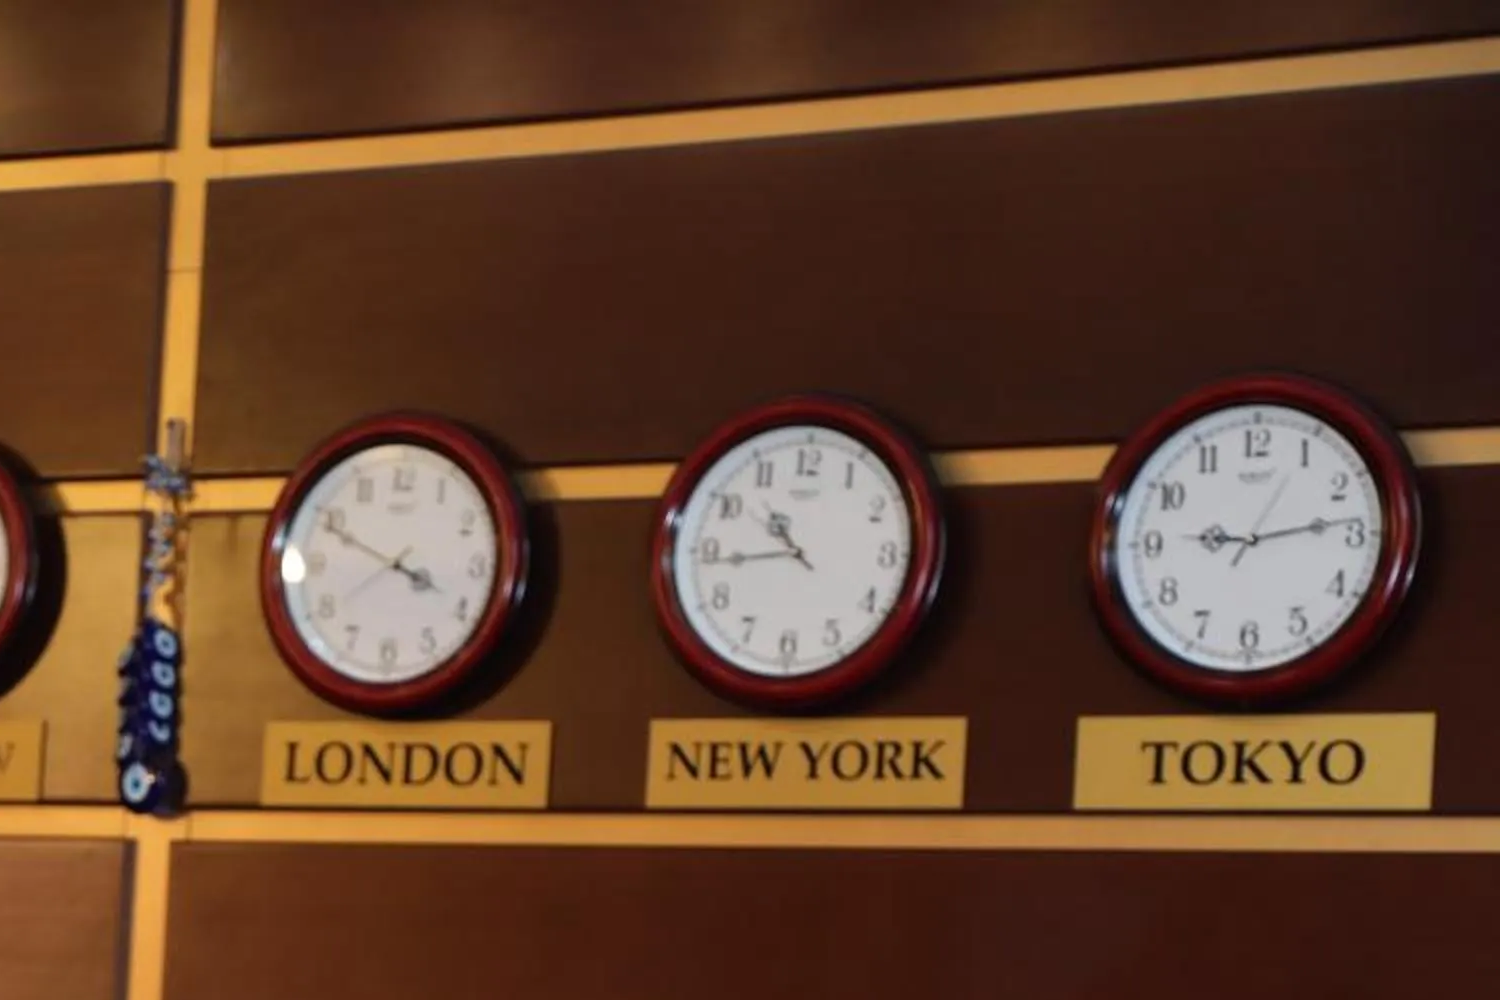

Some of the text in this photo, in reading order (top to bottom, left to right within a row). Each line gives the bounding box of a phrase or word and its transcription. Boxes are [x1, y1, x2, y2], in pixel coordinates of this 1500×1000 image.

[1244, 429, 1271, 458] 12
[1300, 438, 1309, 468] 1
[796, 449, 822, 477] 12
[1197, 444, 1218, 474] 11
[393, 466, 416, 491] 12
[756, 461, 773, 488] 11
[845, 462, 854, 490] 1
[1330, 471, 1349, 501] 2
[356, 478, 374, 503] 11
[437, 478, 446, 504] 1
[1160, 481, 1186, 511] 10
[719, 494, 743, 520] 10
[868, 496, 885, 523] 2
[459, 509, 475, 536] 2
[1345, 518, 1365, 548] 3
[701, 538, 720, 564] 9
[877, 541, 897, 568] 3
[1143, 530, 1163, 559] 9
[468, 553, 486, 578] 3
[712, 583, 730, 610] 8
[1158, 576, 1178, 606] 8
[1325, 569, 1345, 598] 4
[318, 594, 335, 618] 8
[455, 597, 467, 621] 4
[860, 586, 876, 613] 4
[741, 615, 757, 643] 7
[823, 619, 840, 646] 5
[1193, 609, 1211, 638] 7
[1239, 620, 1259, 648] 6
[1288, 606, 1308, 636] 5
[345, 625, 359, 649] 7
[379, 638, 398, 663] 6
[421, 627, 436, 653] 5
[779, 630, 798, 656] 6
[284, 740, 530, 787] LONDON
[665, 739, 948, 781] NEW YORK
[1140, 739, 1366, 786] TOKYO
